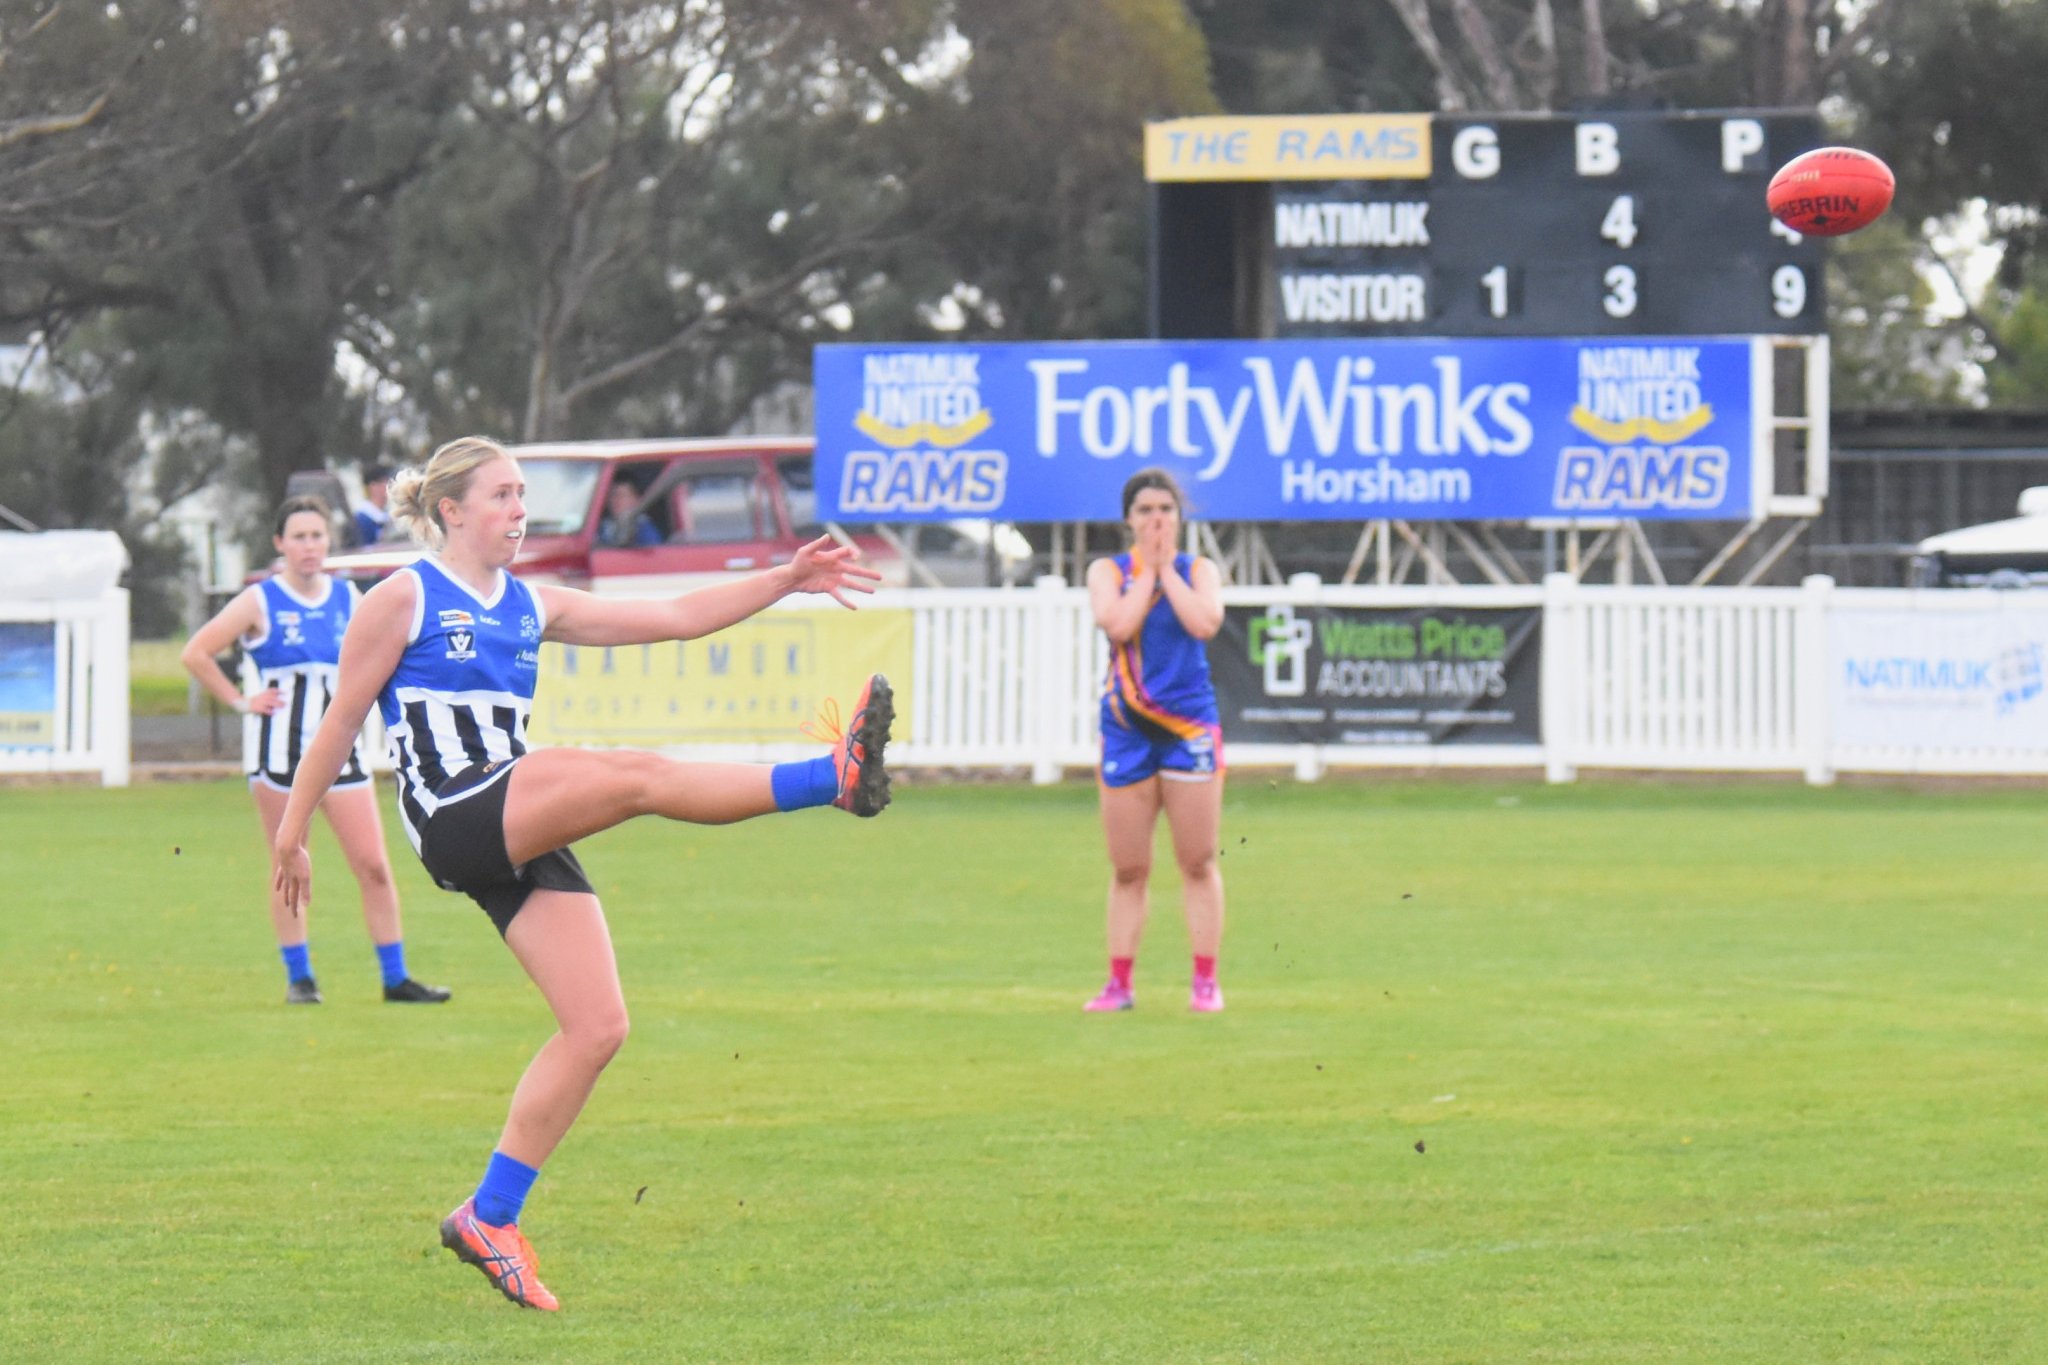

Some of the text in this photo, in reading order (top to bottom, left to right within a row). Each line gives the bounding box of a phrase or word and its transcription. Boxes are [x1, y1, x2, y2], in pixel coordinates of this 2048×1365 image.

[1166, 127, 1420, 165] THE RAMS
[1452, 119, 1764, 179] G B P
[1274, 195, 1638, 249] NATIMUK 4
[1280, 265, 1806, 323] VISITOR 1 3 9
[862, 352, 981, 385] NATIMUK
[1578, 347, 1701, 379] NATIMUK
[862, 384, 982, 427] UNITED
[1578, 378, 1702, 423] UNITED
[839, 449, 1009, 512] RAMS
[1281, 458, 1472, 503] Horsham
[1552, 445, 1731, 510] RAMS
[1317, 615, 1507, 660] Watts Price
[1316, 660, 1508, 698] ACCOUNTANTS
[1845, 658, 1993, 690] NATIMUK
